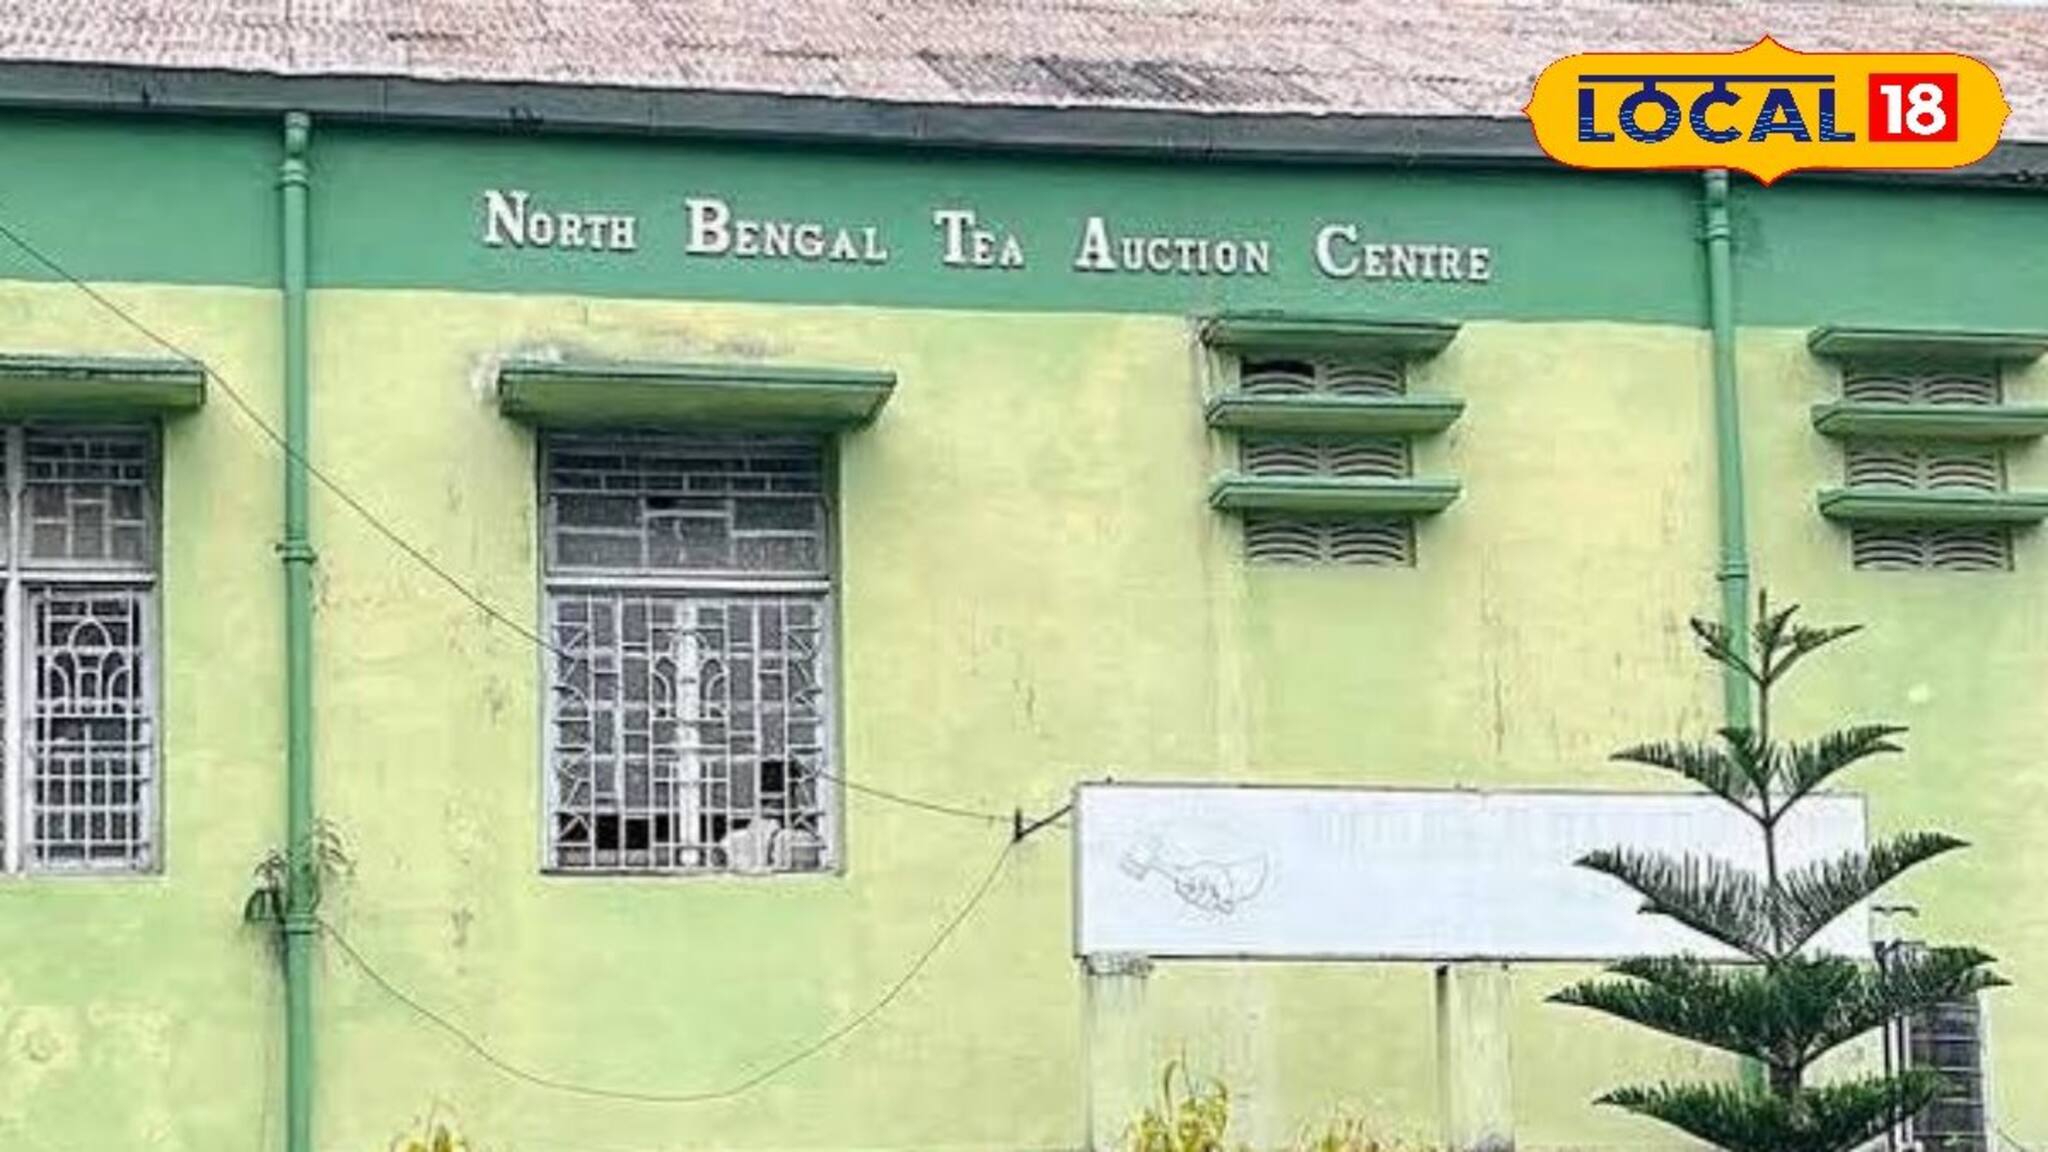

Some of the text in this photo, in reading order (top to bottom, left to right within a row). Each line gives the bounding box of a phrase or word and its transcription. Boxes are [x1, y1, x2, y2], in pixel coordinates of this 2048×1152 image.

[483, 189, 1492, 281] NORTH BENGAL TEA AUCTION CENTRE
